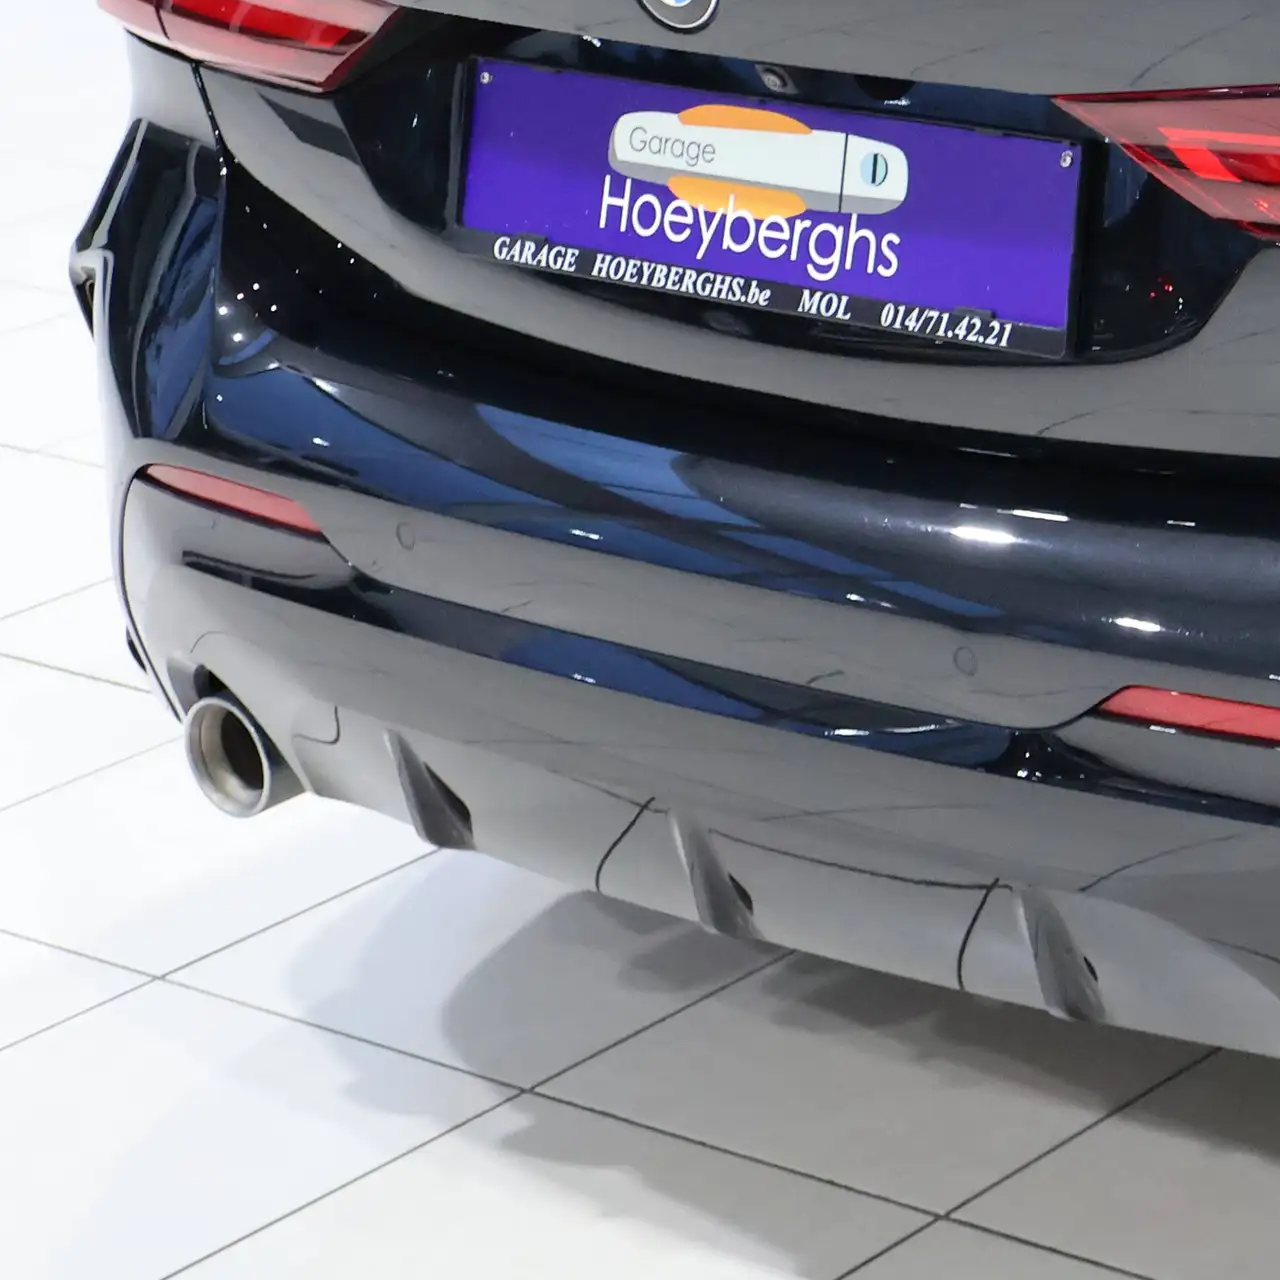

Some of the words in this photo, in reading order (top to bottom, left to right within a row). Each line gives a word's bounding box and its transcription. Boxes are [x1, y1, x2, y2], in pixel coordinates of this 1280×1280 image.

[628, 126, 717, 167] Garage
[599, 174, 901, 282] Hoeyberghs
[493, 236, 580, 273] GARAGE
[590, 253, 772, 307] HOEYBERGHS.be
[797, 288, 852, 321] MOL
[879, 302, 1013, 348] 014/71.42.21
